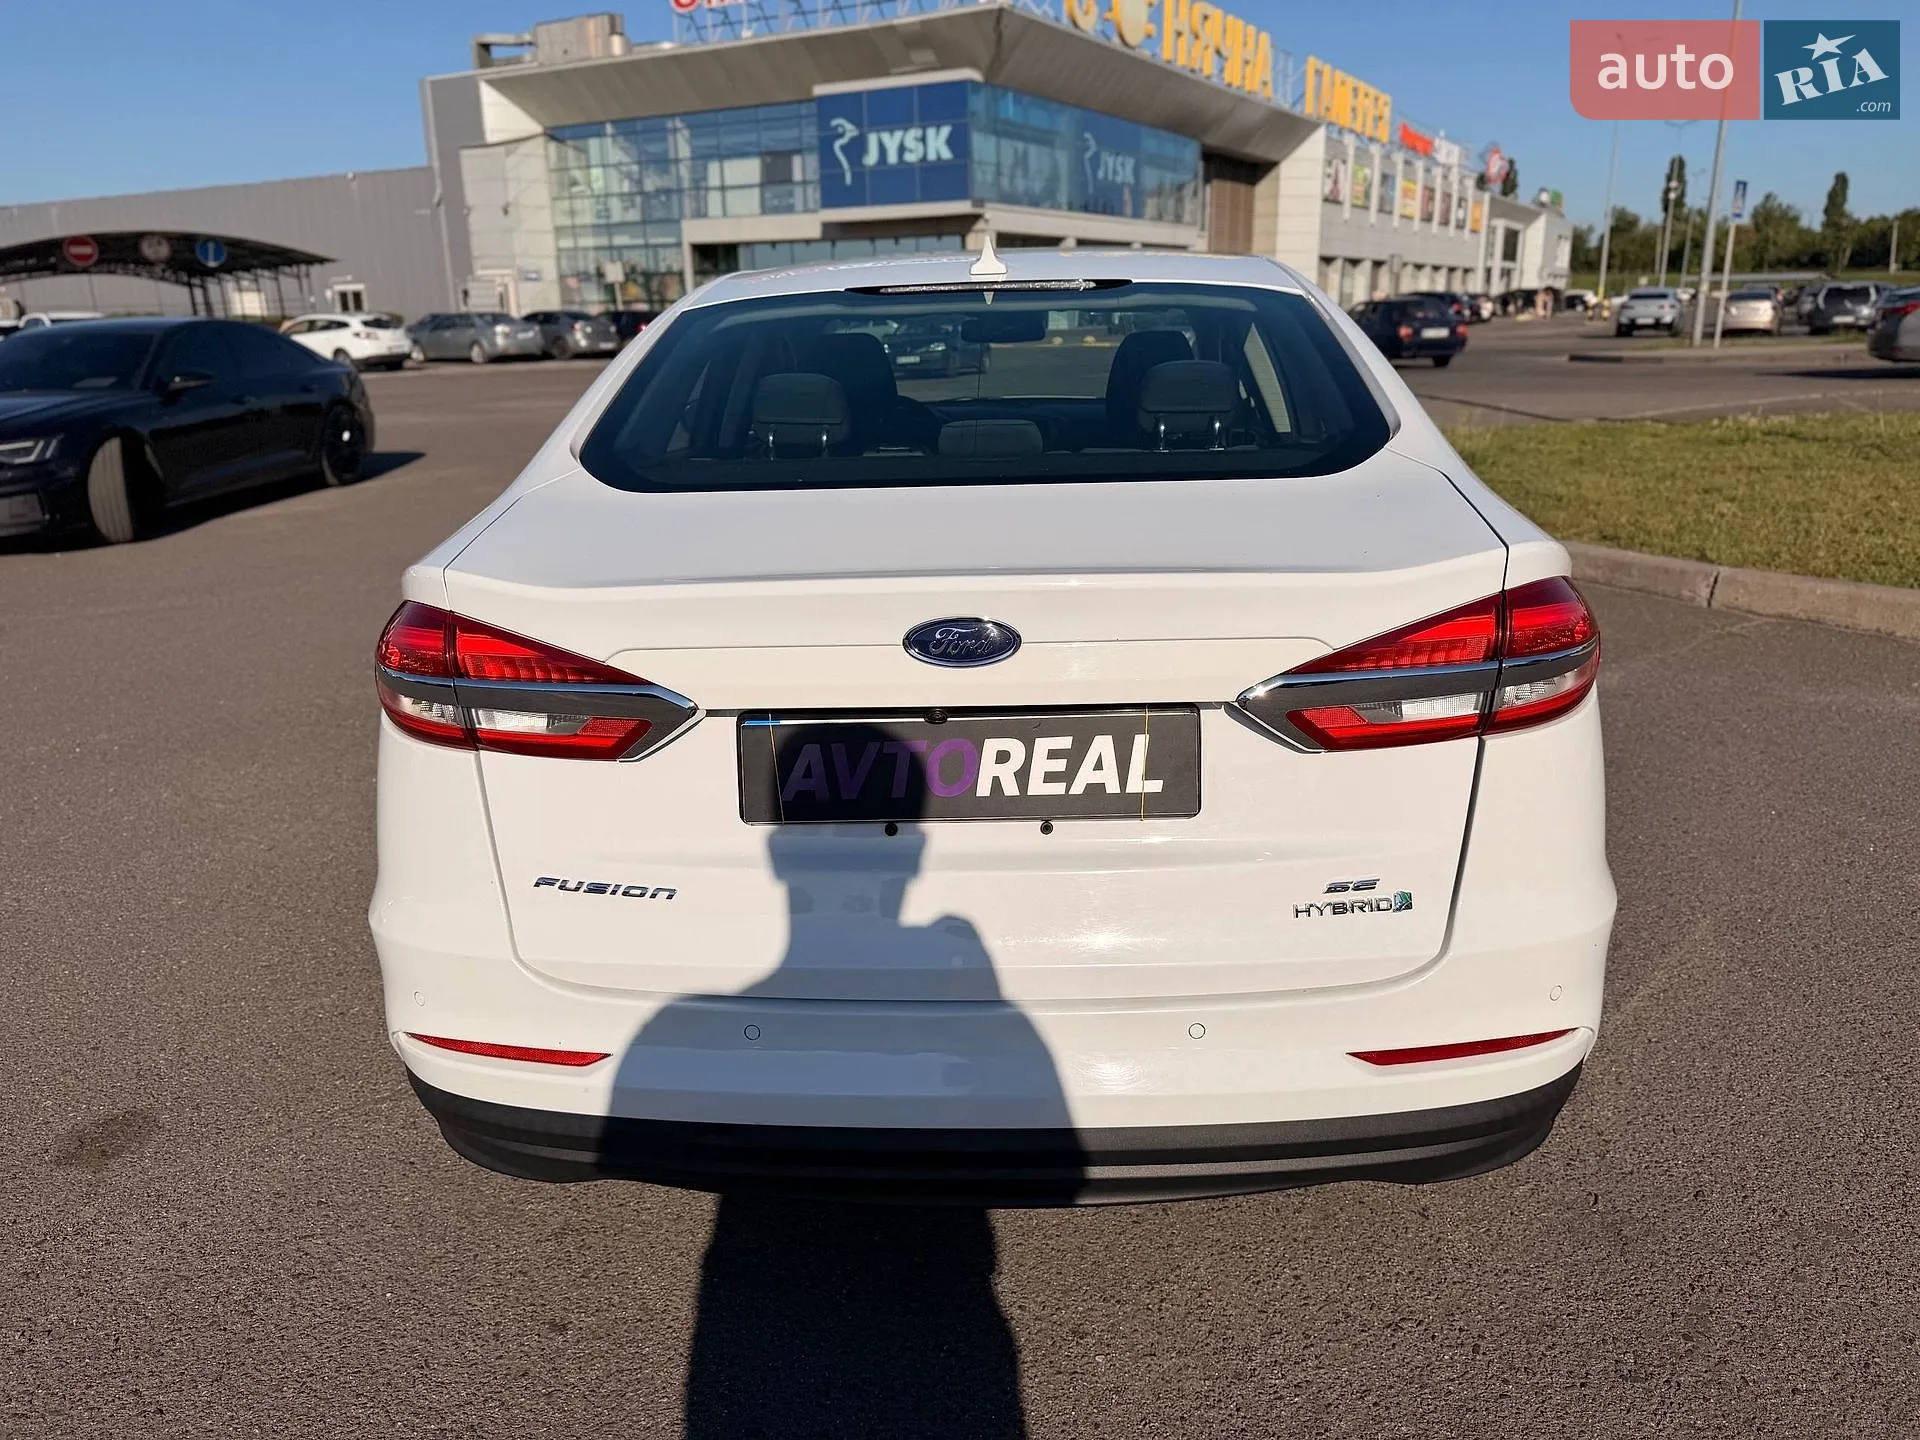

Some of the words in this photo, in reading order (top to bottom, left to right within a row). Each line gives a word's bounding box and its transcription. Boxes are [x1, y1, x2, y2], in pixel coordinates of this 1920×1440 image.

[862, 125, 954, 166] JYSK
[1096, 151, 1136, 184] JYSK
[928, 627, 993, 655] Ford
[782, 733, 1165, 802] AVTOREAL
[533, 876, 678, 900] FUSION
[1324, 878, 1381, 894] SE
[1293, 896, 1393, 918] HYBRID
